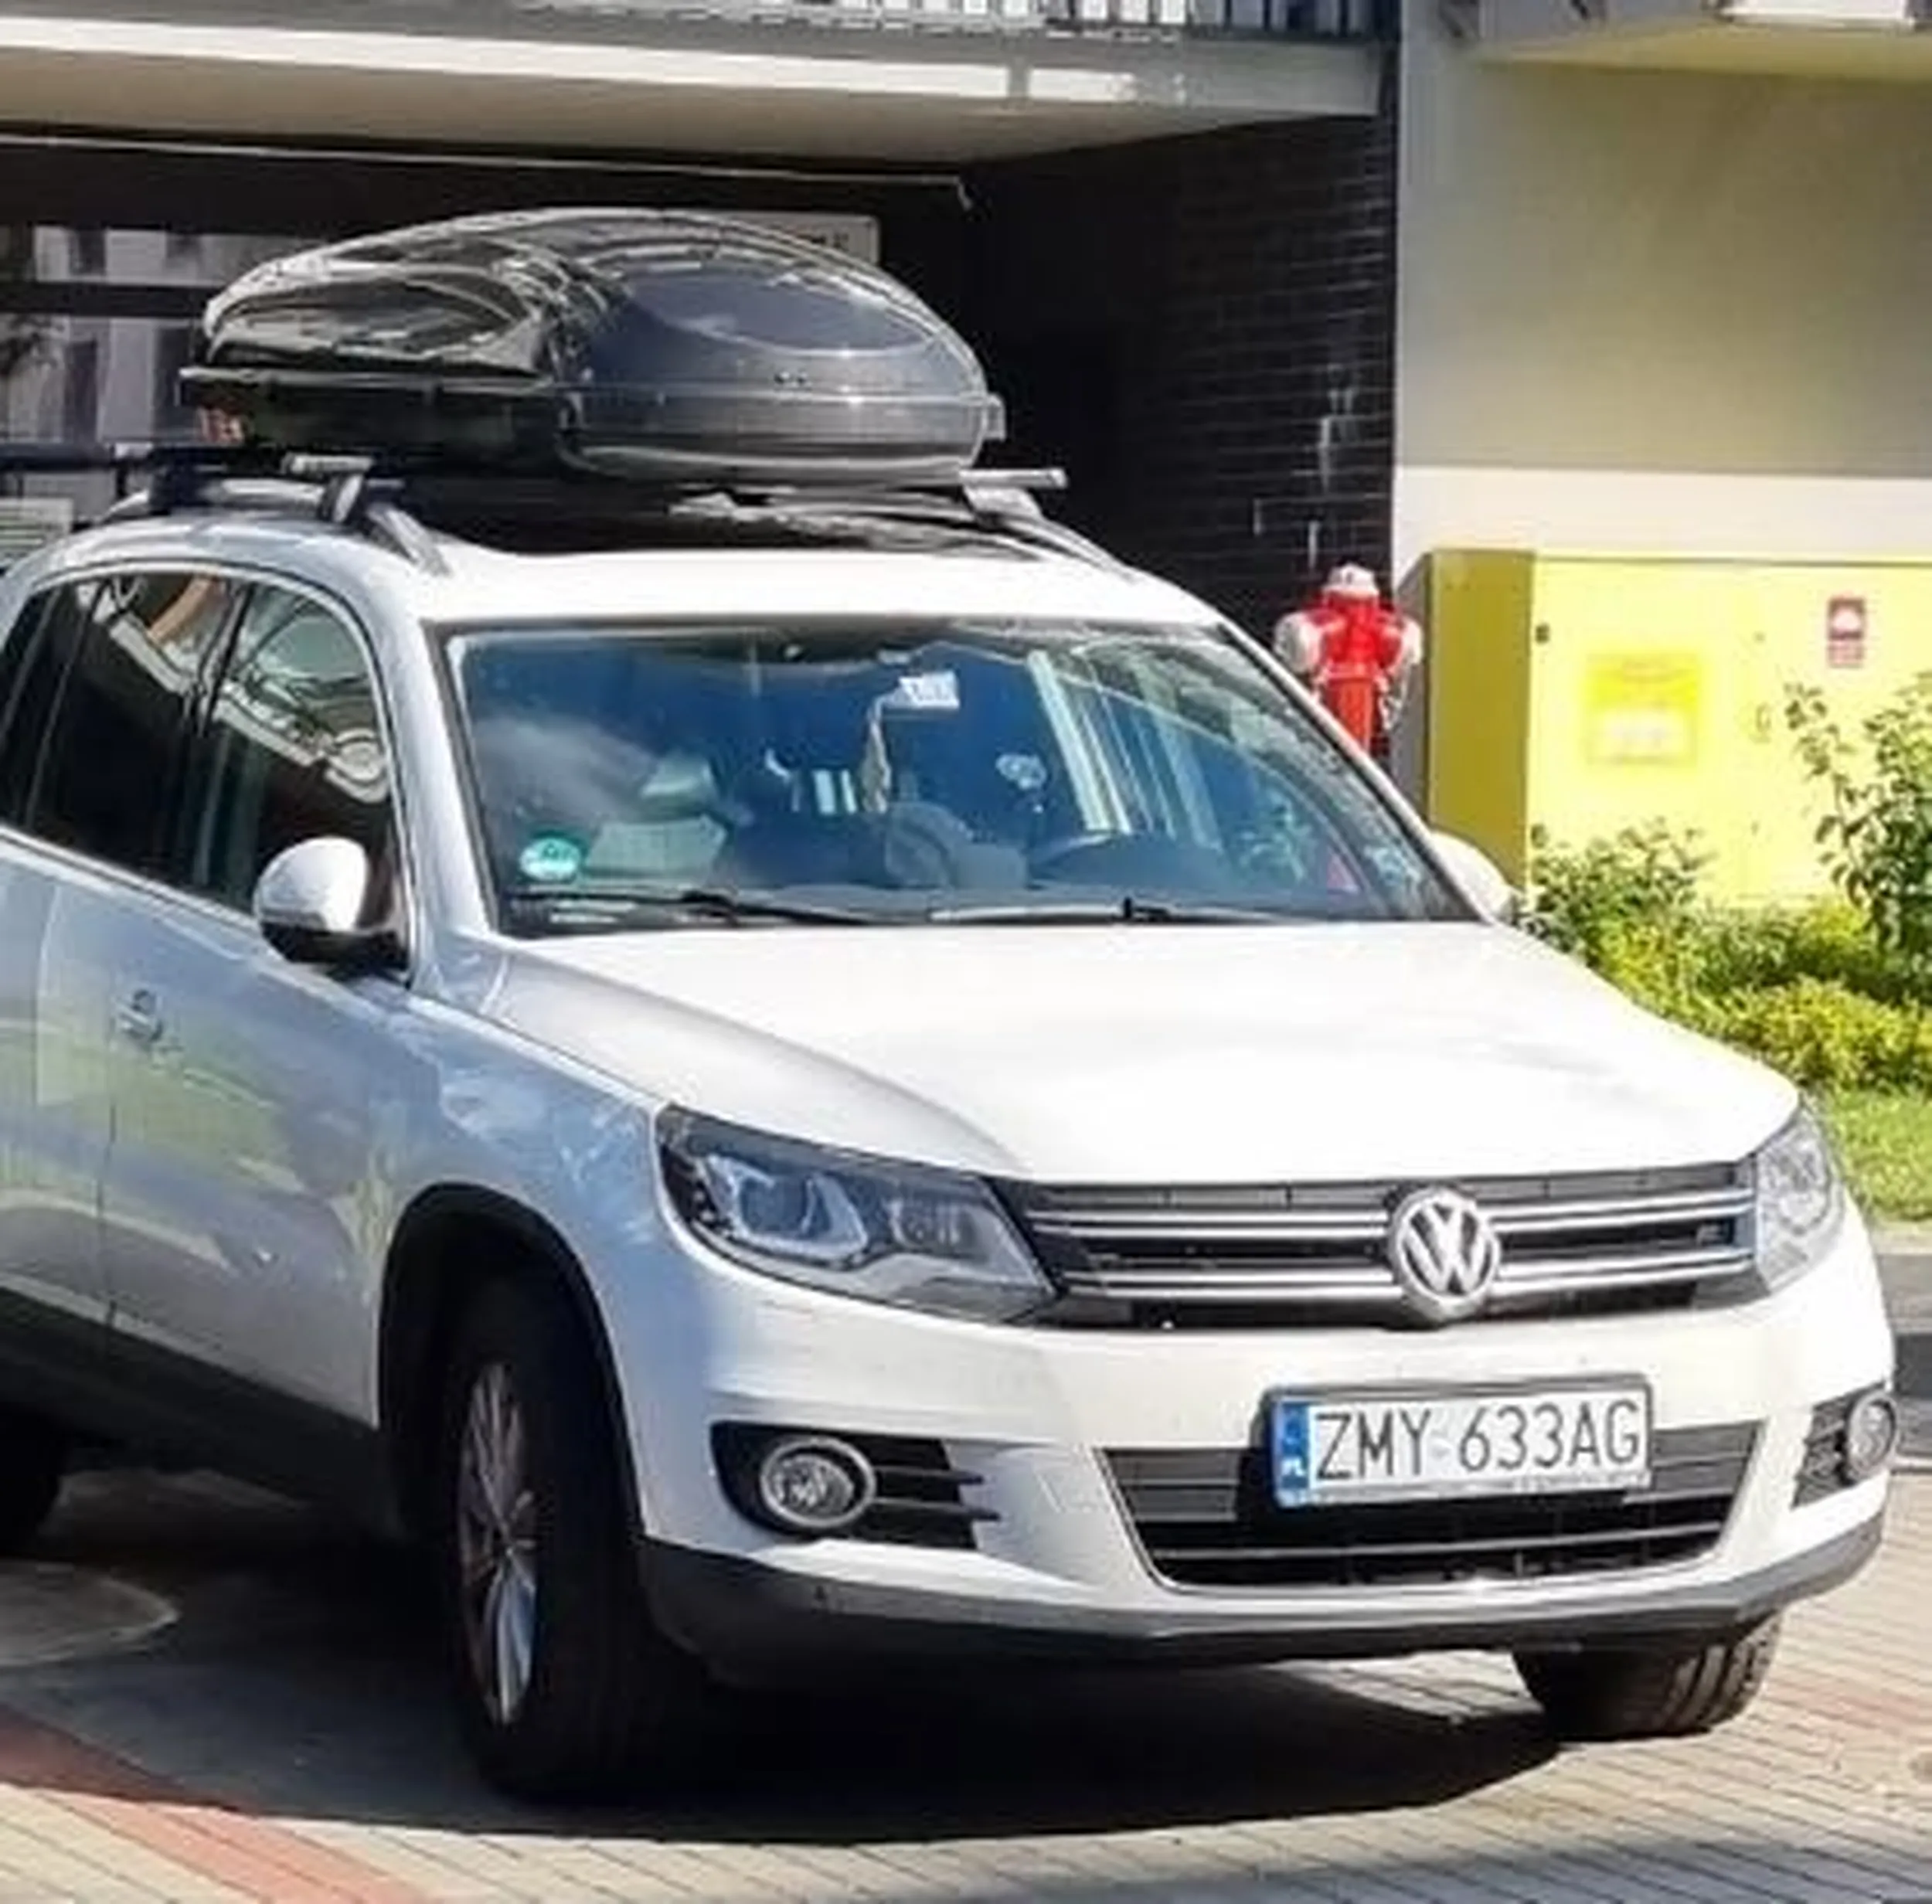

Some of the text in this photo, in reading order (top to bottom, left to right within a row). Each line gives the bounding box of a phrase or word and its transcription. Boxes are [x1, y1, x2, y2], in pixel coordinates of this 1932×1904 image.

[1400, 1195, 1496, 1298] VW
[1315, 1399, 1639, 1481] ZMY 633AG
